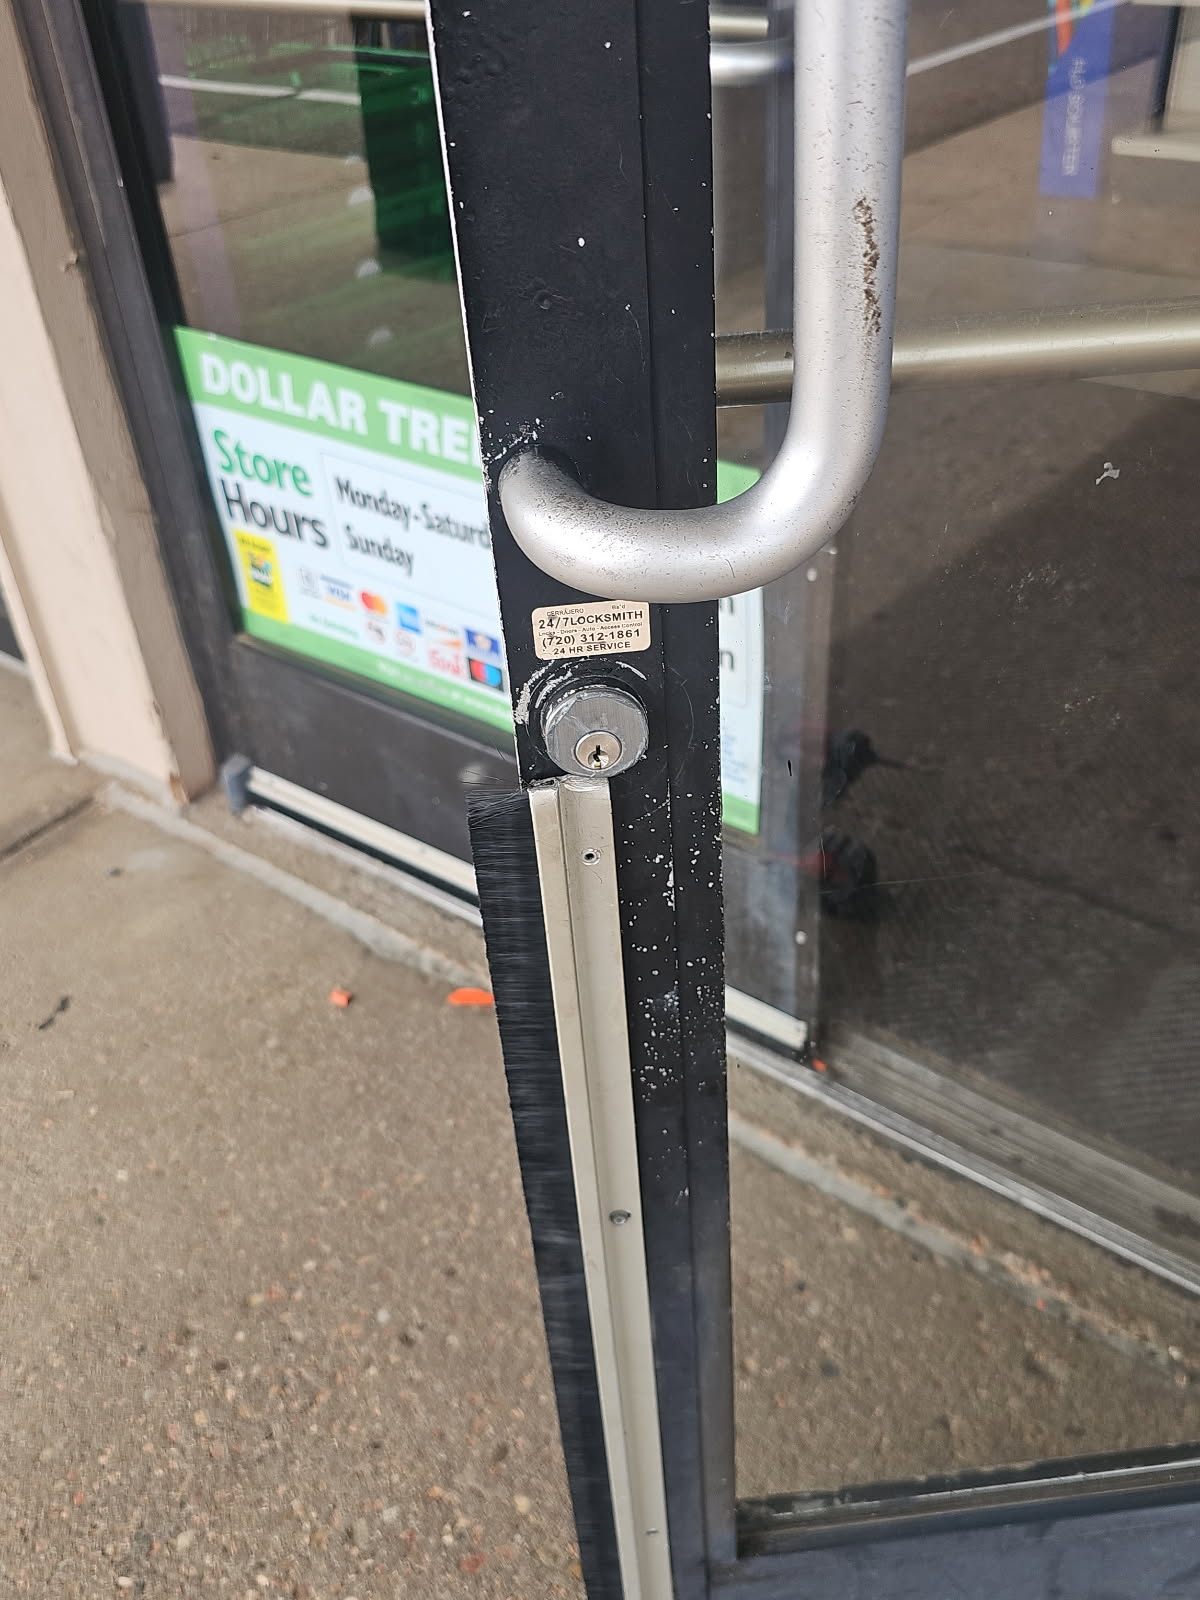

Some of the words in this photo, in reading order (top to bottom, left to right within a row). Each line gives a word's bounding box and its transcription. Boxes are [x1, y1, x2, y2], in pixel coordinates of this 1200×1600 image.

[199, 353, 369, 436] DOLLAR
[212, 428, 313, 497] Store
[218, 478, 330, 550] Hours
[344, 523, 414, 578] Sunday
[542, 635, 575, 649] (720)
[580, 629, 640, 643] 312-1861
[553, 648, 566, 656] 24
[569, 645, 584, 654] HR
[586, 641, 632, 652] SERVICE
